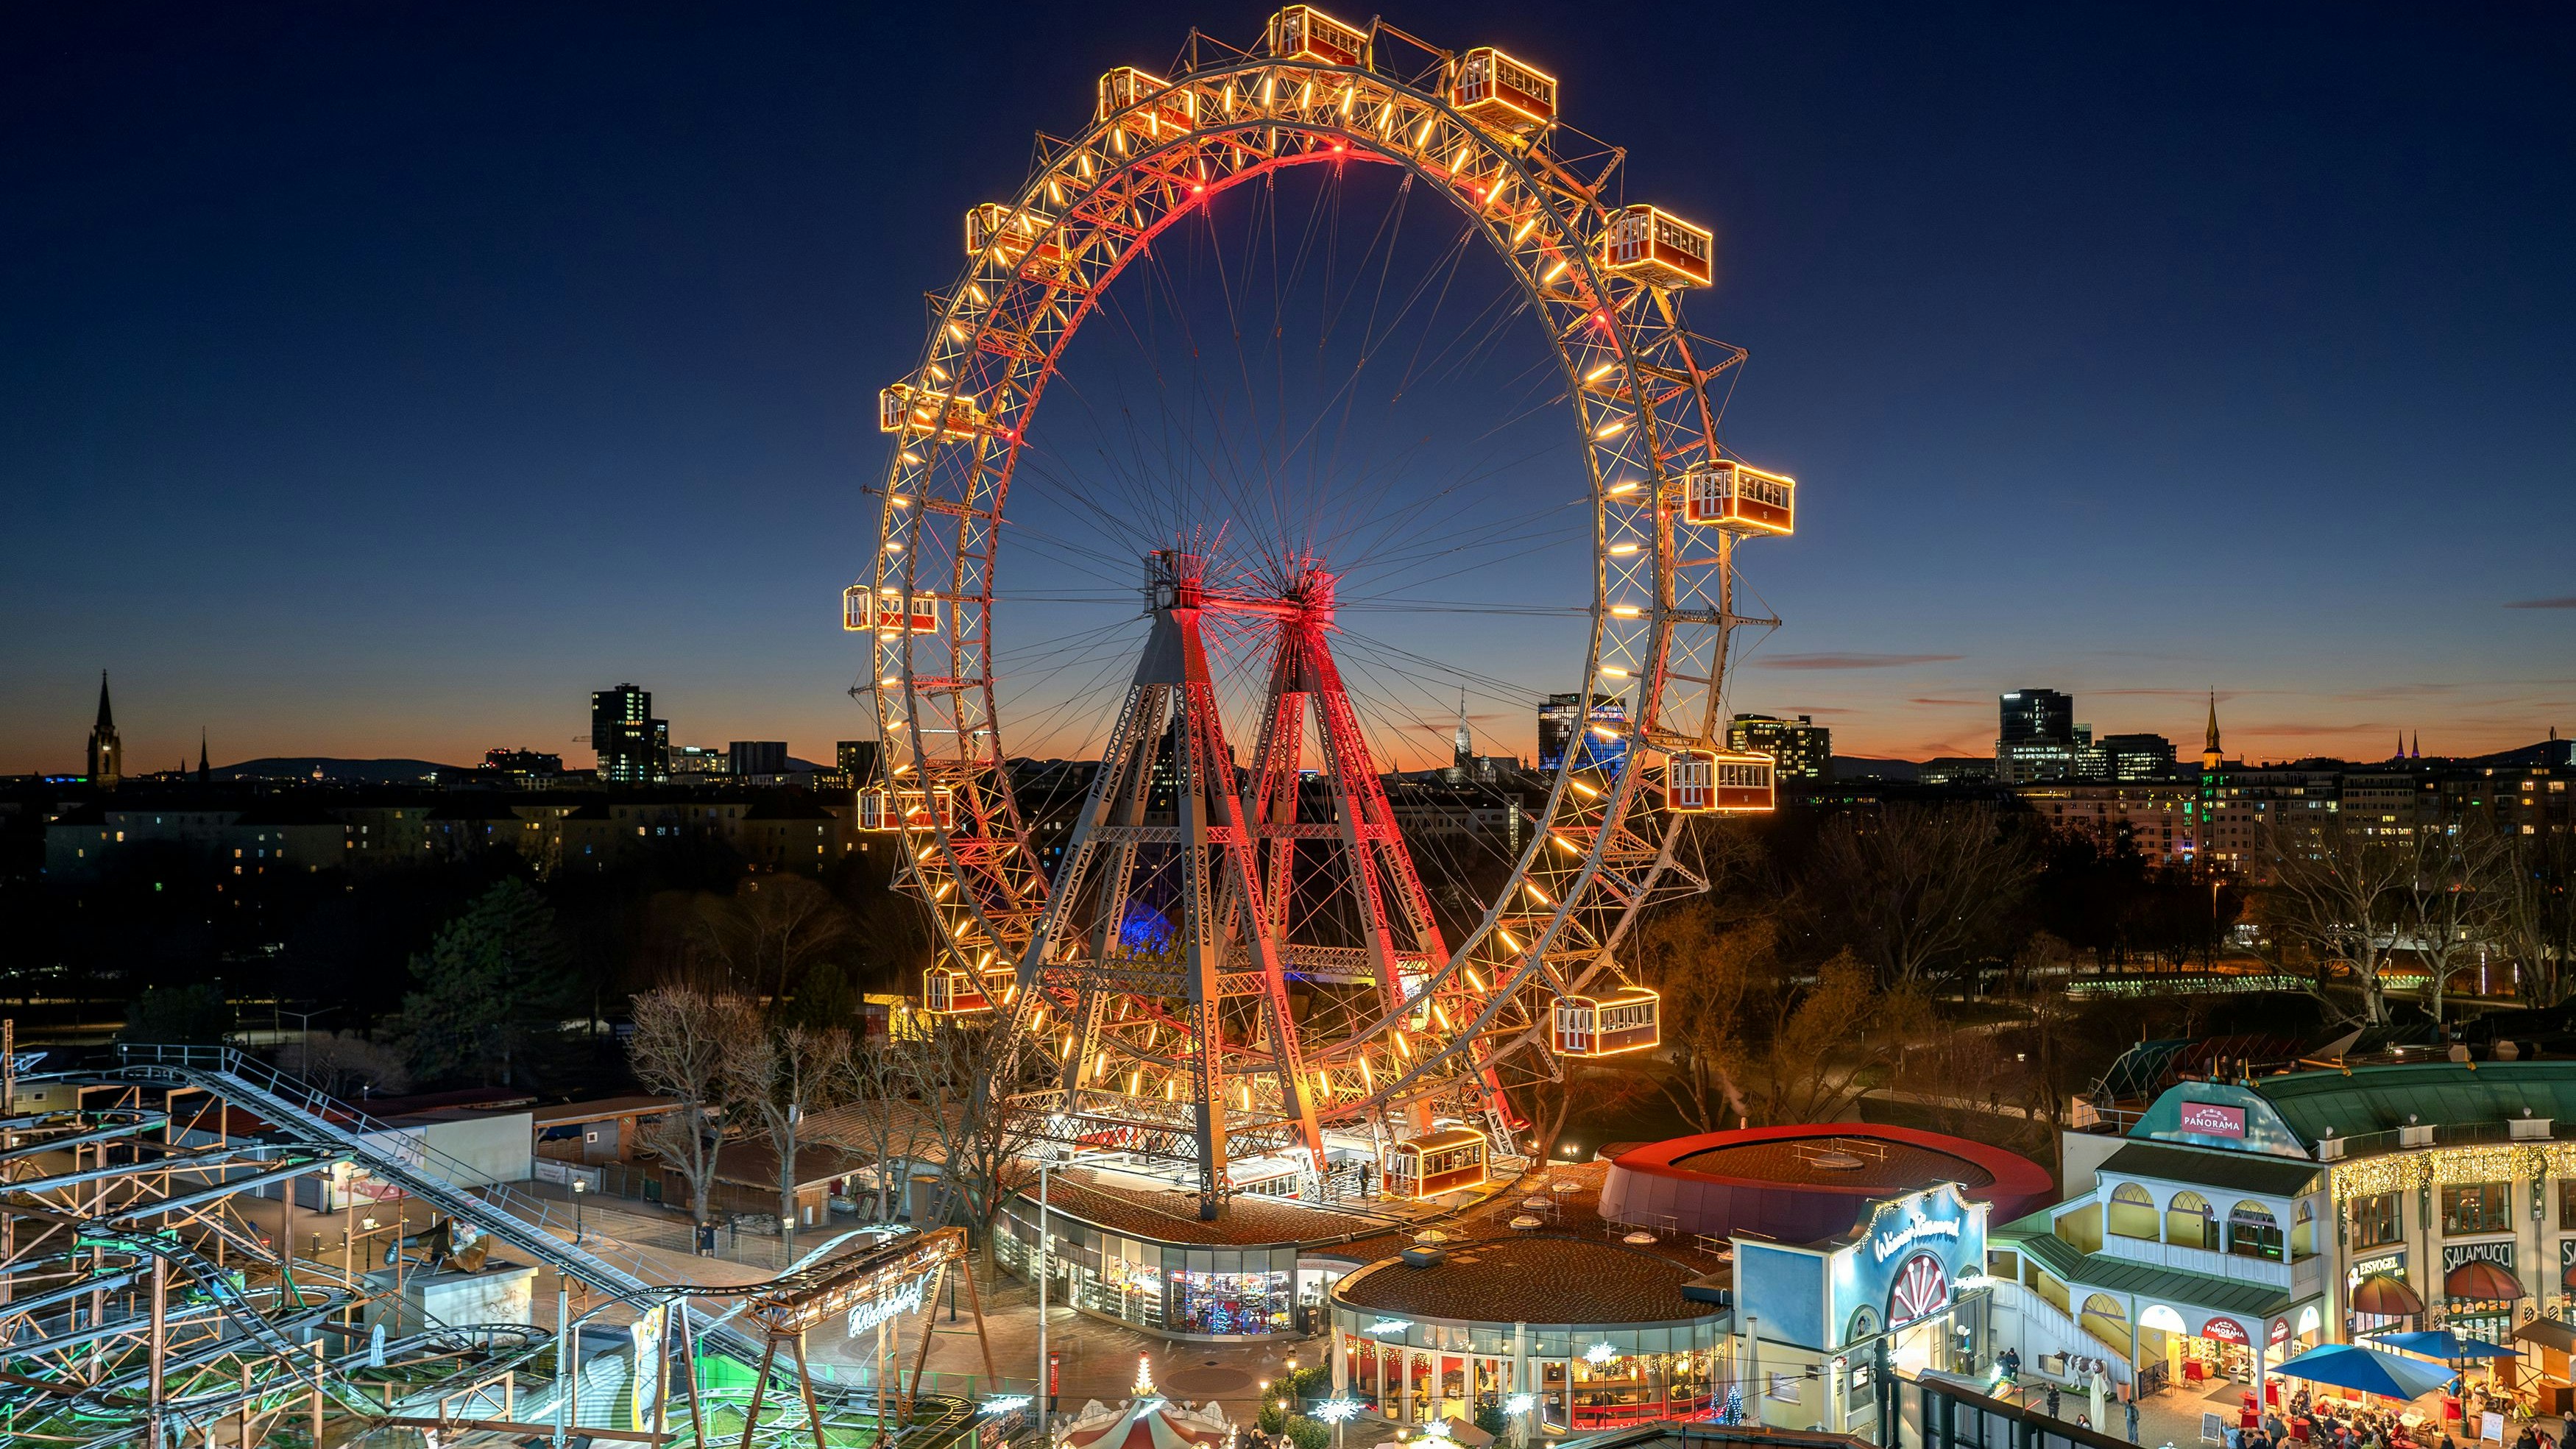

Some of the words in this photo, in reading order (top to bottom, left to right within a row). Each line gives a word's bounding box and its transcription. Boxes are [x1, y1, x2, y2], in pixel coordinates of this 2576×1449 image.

[2184, 1116, 2240, 1131] PANORAMA
[2359, 1256, 2398, 1275] EISVOGEL
[2444, 1243, 2513, 1274] SALAMUCCI
[2207, 1325, 2244, 1338] PANORAMA
